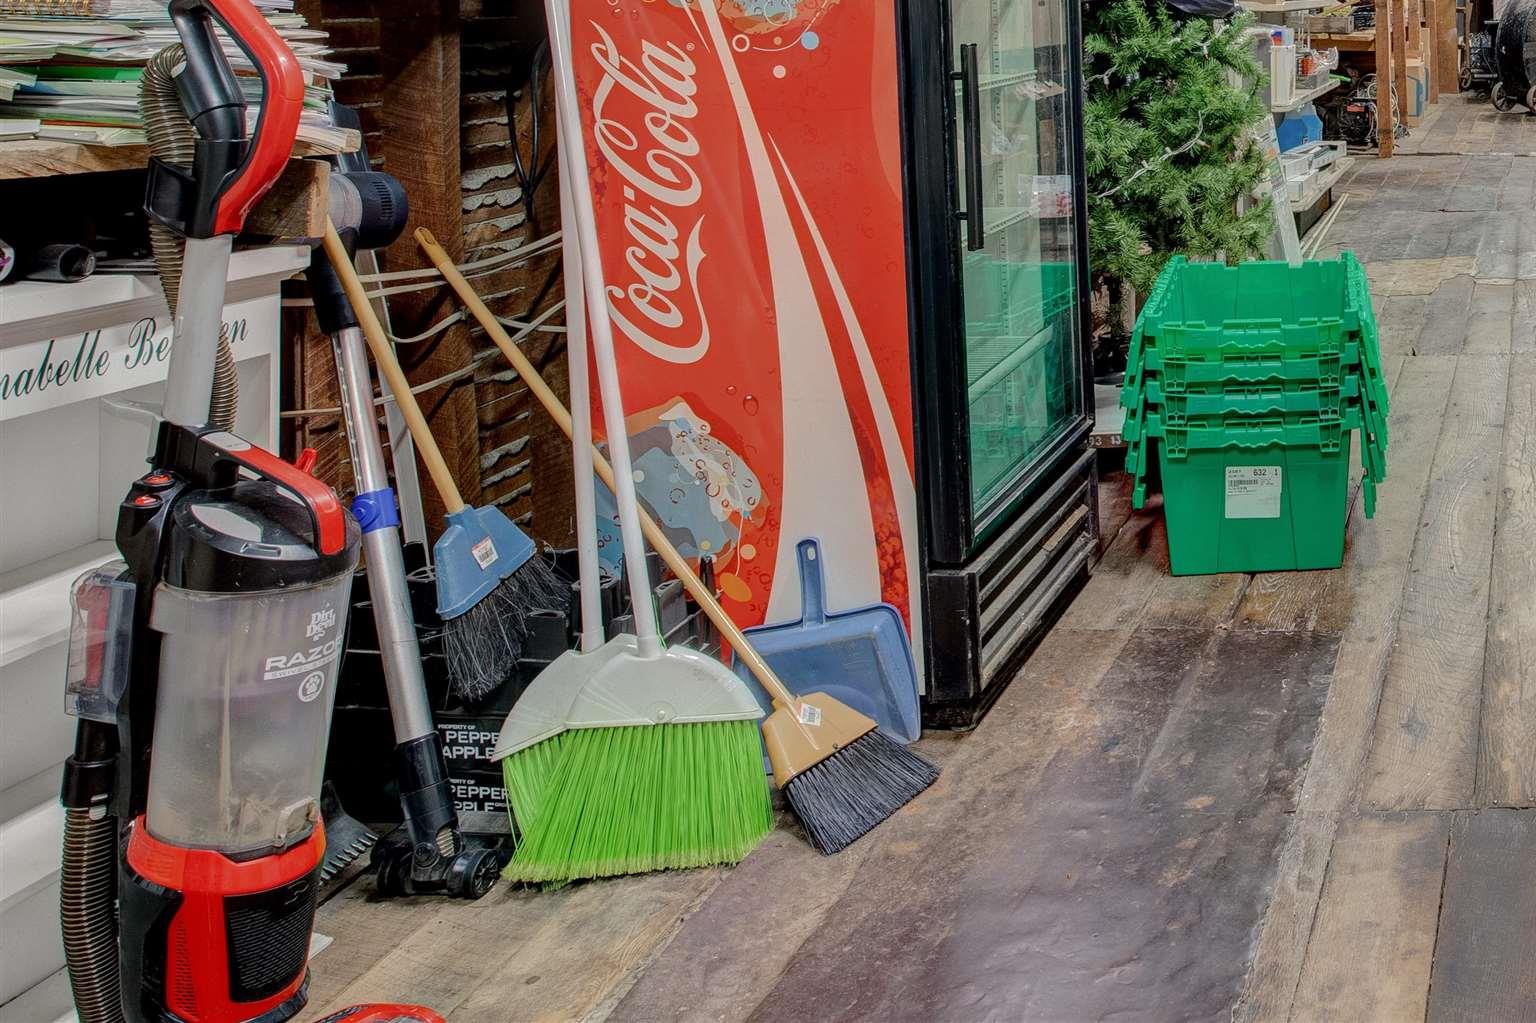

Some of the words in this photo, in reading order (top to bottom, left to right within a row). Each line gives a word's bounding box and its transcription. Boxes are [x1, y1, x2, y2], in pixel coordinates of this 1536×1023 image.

[590, 19, 710, 365] Coca-Cola
[264, 636, 343, 672] RAZO
[442, 746, 495, 759] APPLE
